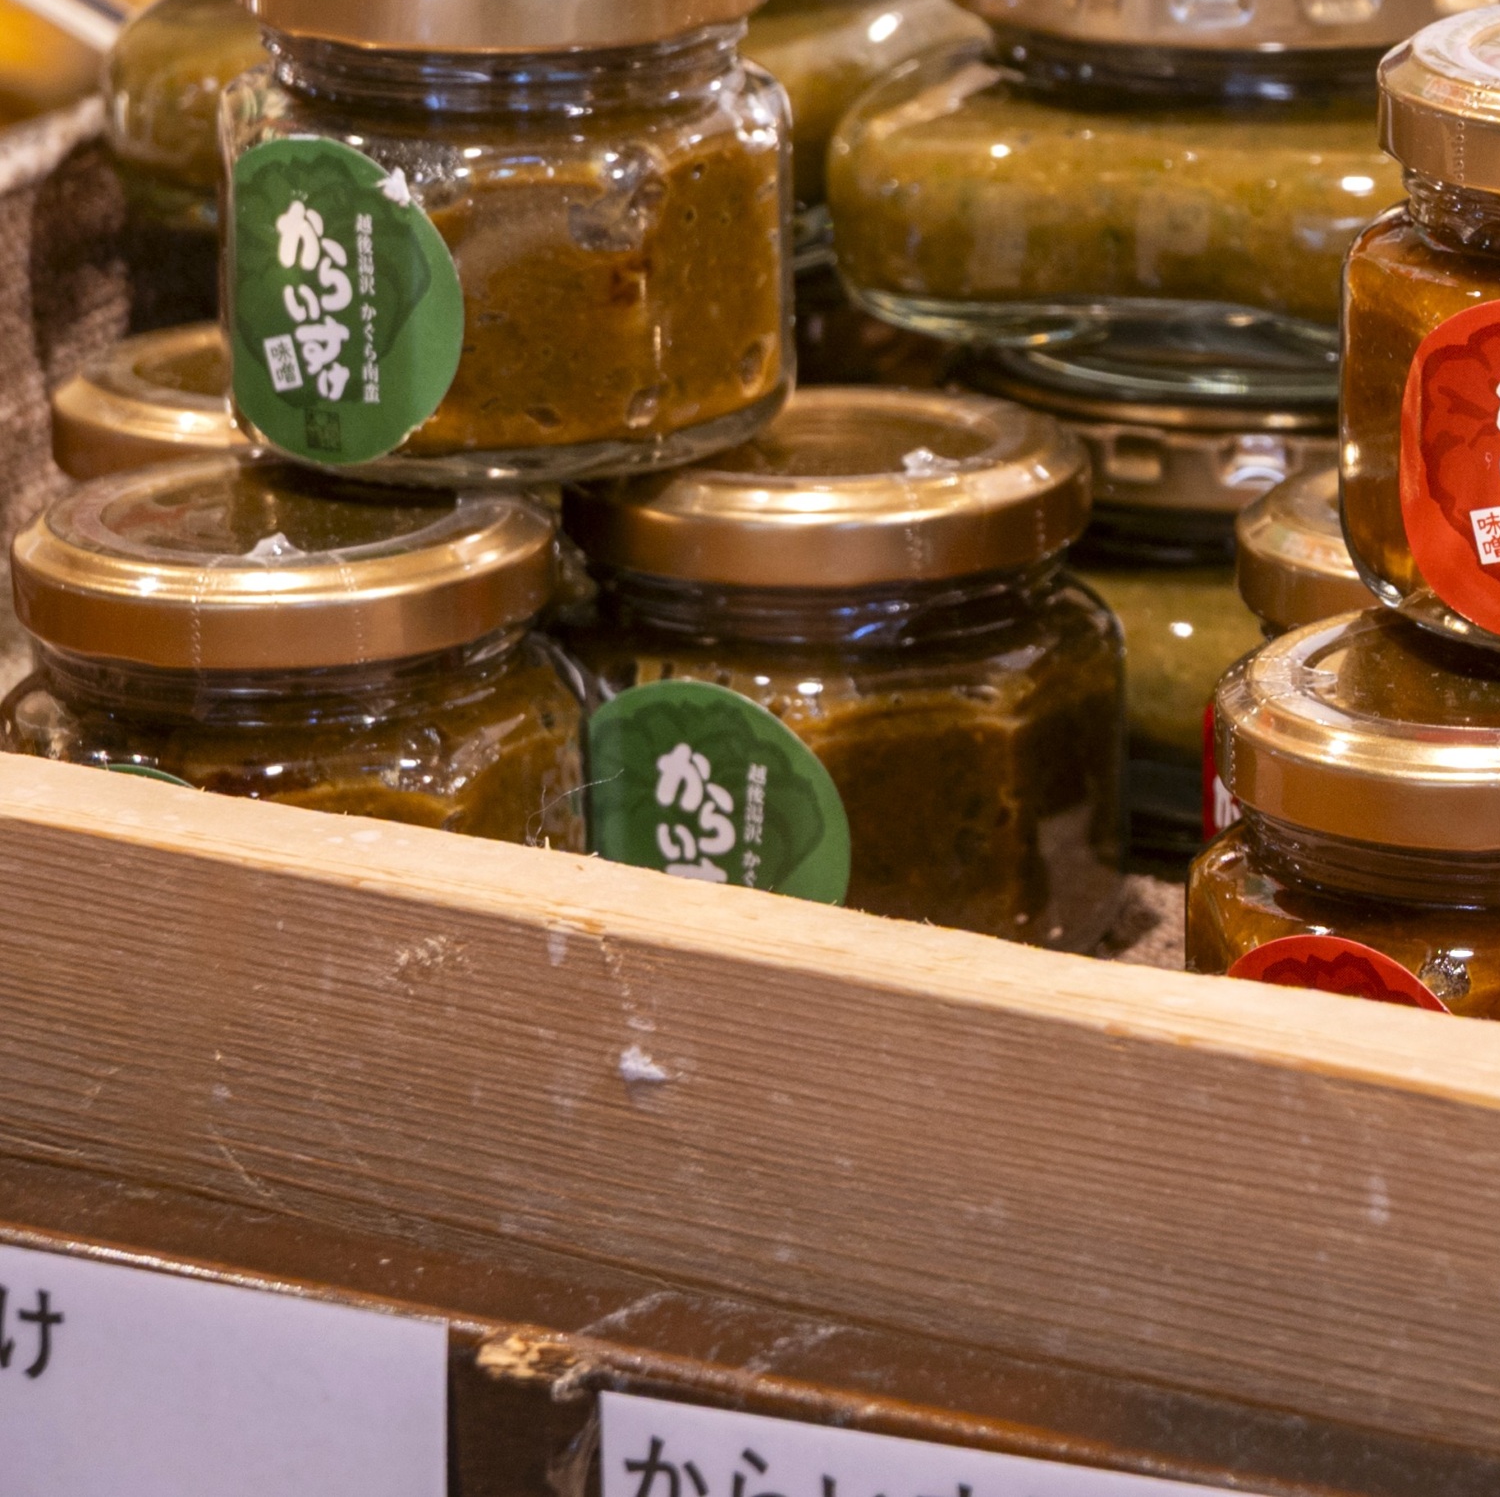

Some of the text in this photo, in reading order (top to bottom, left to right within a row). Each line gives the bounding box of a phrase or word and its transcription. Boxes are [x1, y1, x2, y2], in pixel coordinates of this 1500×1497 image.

[275, 199, 354, 402] からいすけ
